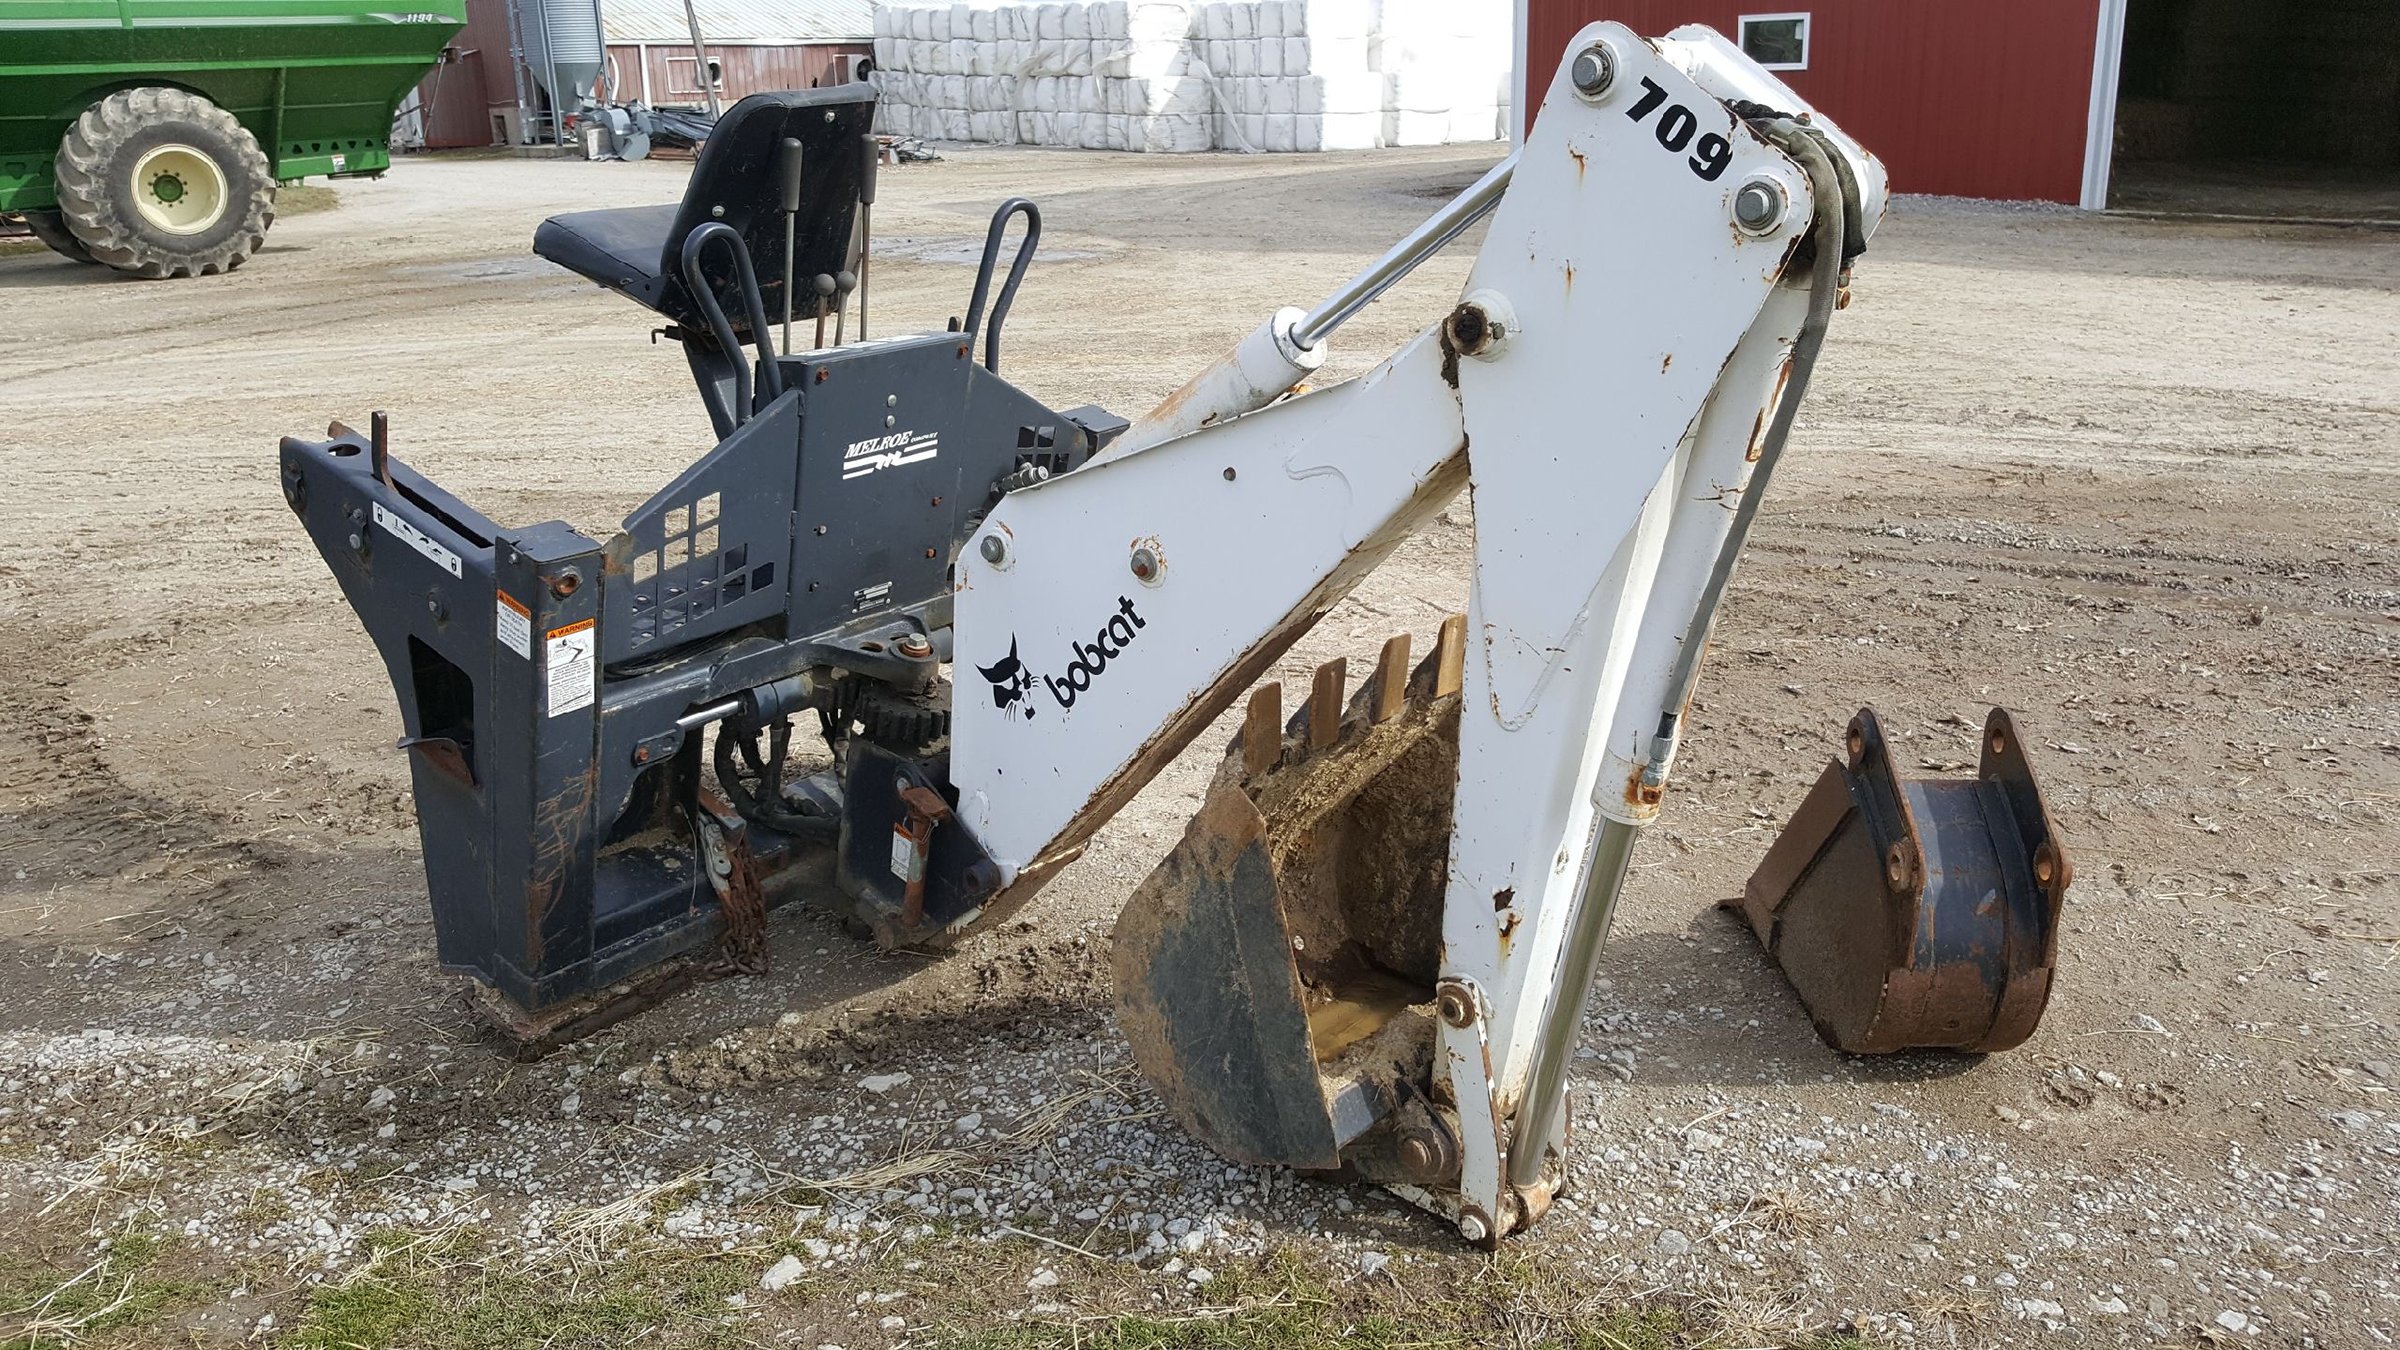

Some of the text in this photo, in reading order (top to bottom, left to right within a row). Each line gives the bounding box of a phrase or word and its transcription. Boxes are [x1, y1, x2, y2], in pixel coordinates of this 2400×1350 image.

[407, 13, 432, 23] 1194
[1625, 75, 1733, 182] 709
[844, 430, 938, 459] MELROE COMPANY
[557, 620, 593, 636] WARNING
[1043, 595, 1146, 708] bobcat
